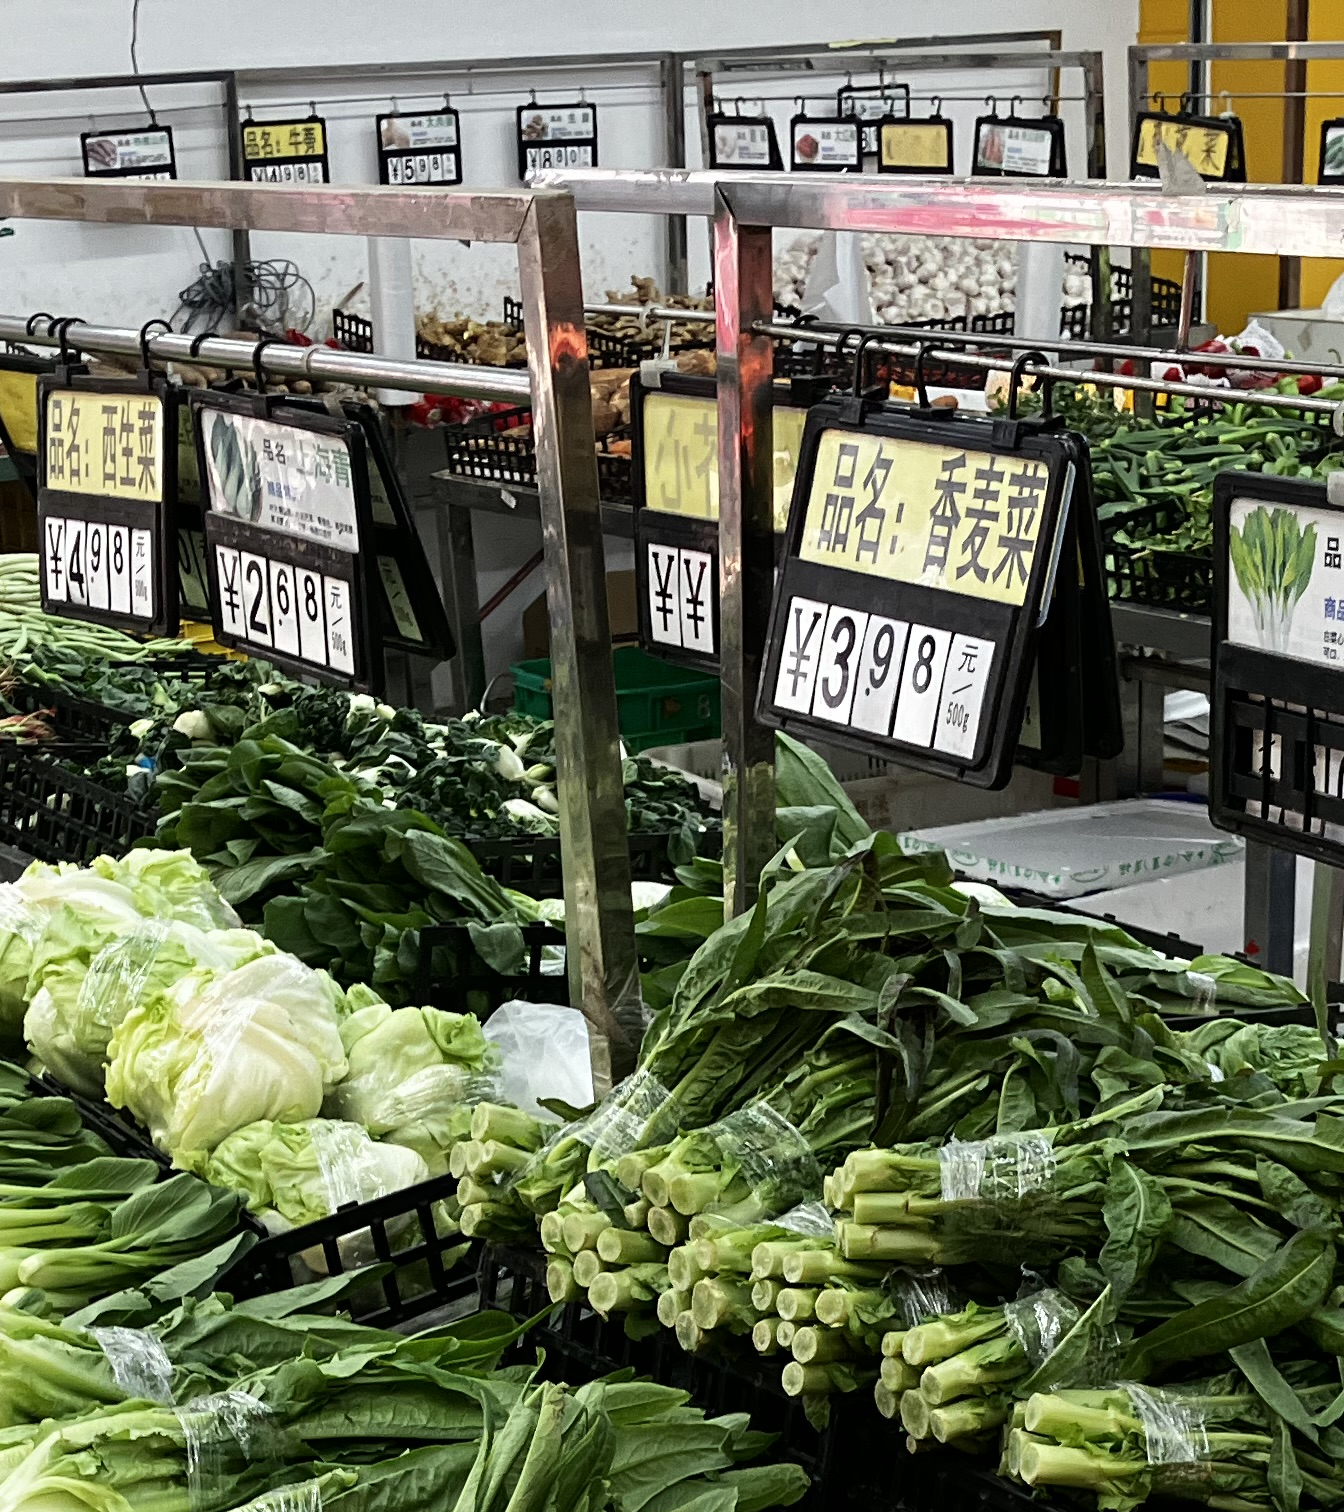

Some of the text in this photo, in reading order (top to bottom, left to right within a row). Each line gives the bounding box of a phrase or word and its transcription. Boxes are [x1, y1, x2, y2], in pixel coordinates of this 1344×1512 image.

[102, 400, 156, 495] 西生菜
[922, 451, 1050, 590] 香麦菜
